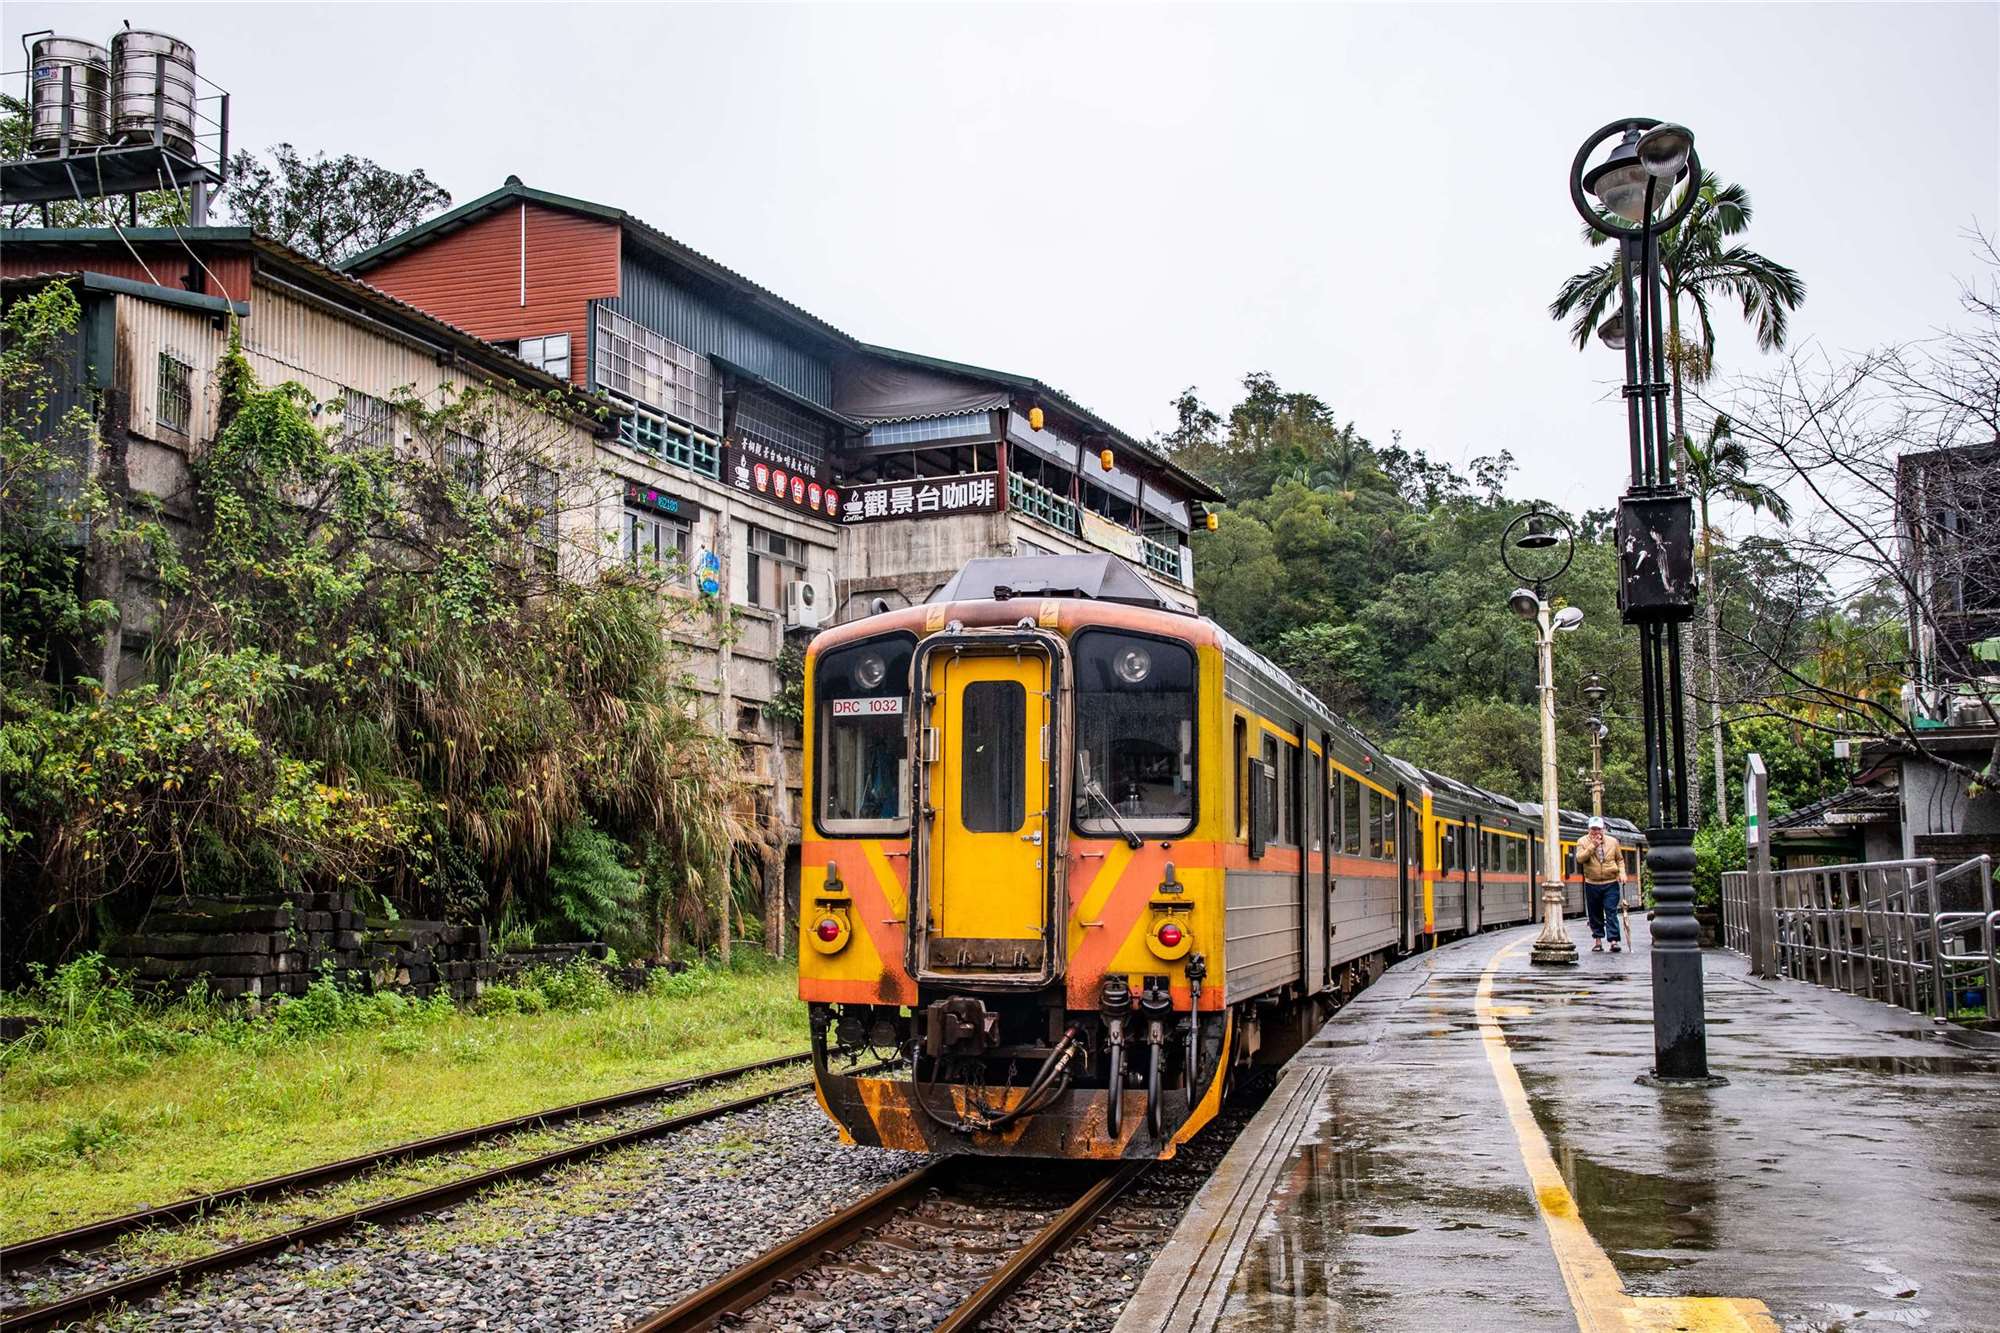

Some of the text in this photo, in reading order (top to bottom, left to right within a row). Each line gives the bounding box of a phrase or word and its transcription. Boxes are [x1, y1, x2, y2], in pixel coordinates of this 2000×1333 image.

[864, 479, 995, 518] 觀景台咖啡
[842, 514, 865, 523] Coffee
[834, 699, 897, 713] DRC 1032
